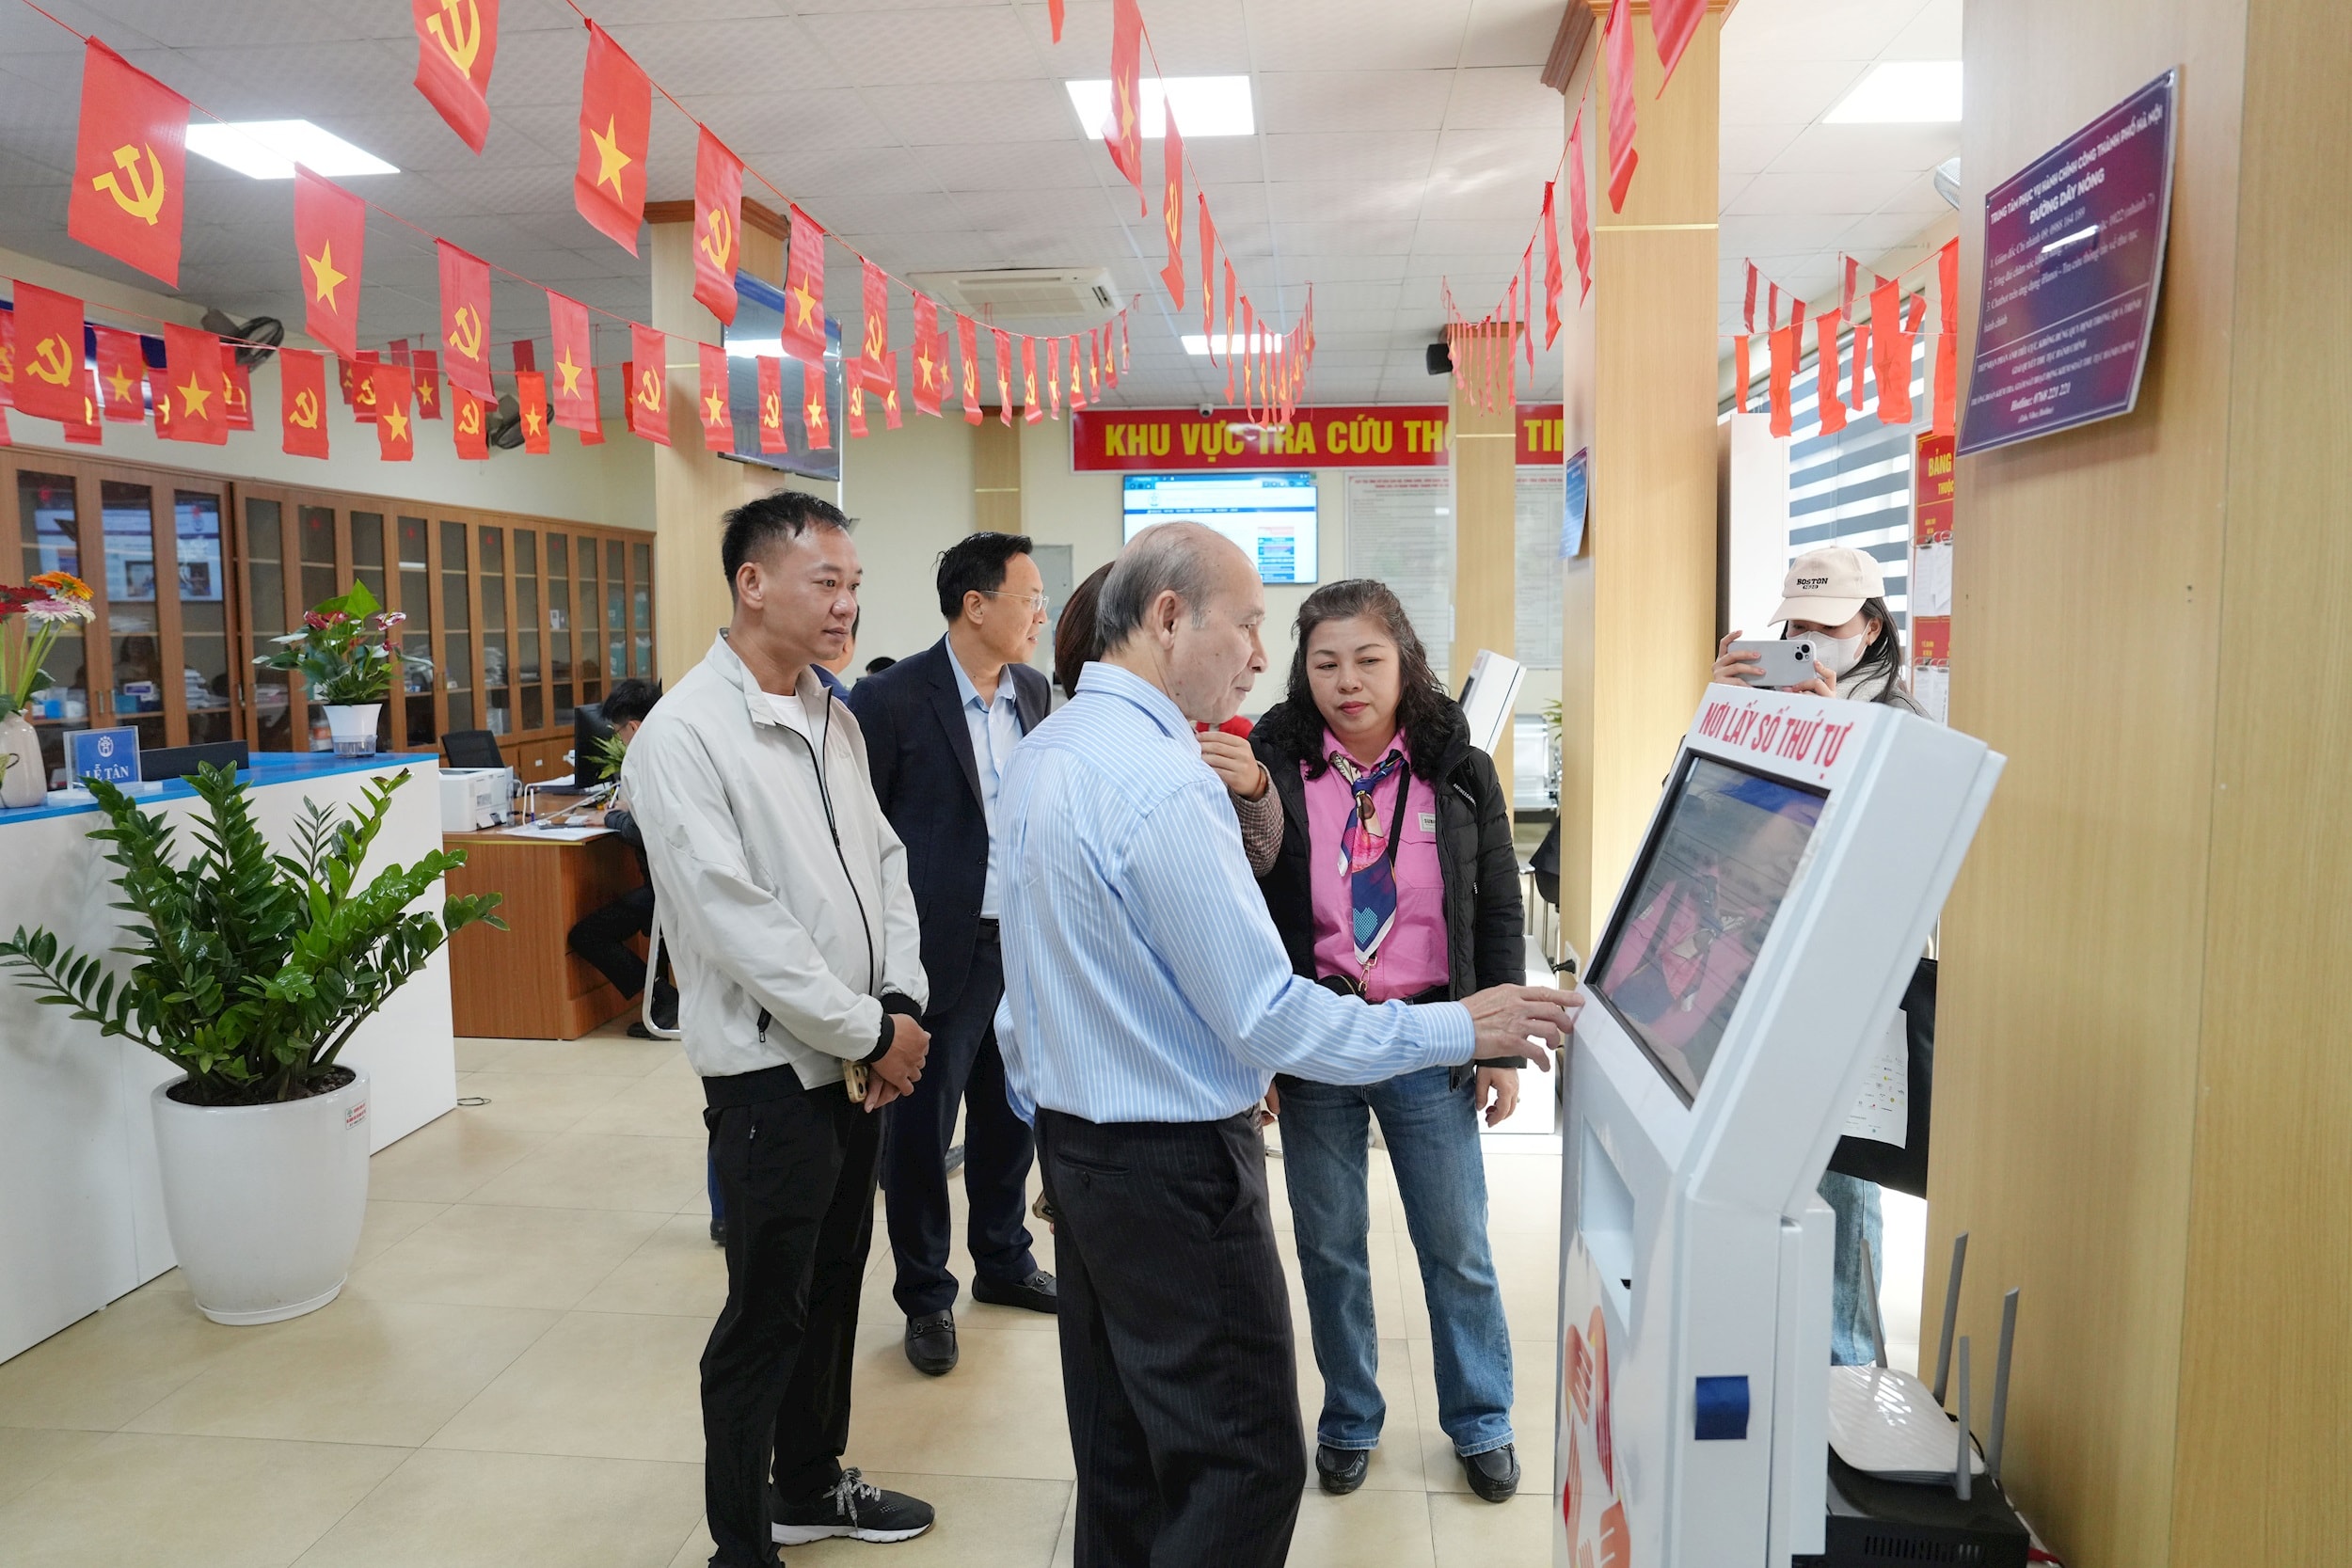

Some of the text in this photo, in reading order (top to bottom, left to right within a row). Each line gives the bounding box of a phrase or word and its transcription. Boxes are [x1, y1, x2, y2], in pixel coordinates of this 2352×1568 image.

[2059, 184, 2076, 205] DÂY
[2077, 168, 2104, 195] NÓNG
[1105, 423, 1171, 456] KHU
[1181, 420, 1246, 463] VỰC
[1259, 421, 1316, 454] TRA
[1327, 414, 1393, 454] CỨU
[1928, 448, 1952, 477] BẢNG
[1698, 700, 1854, 780] NƠI LẤY SỐ THỨ TỰ
[103, 764, 129, 780] TÂN
